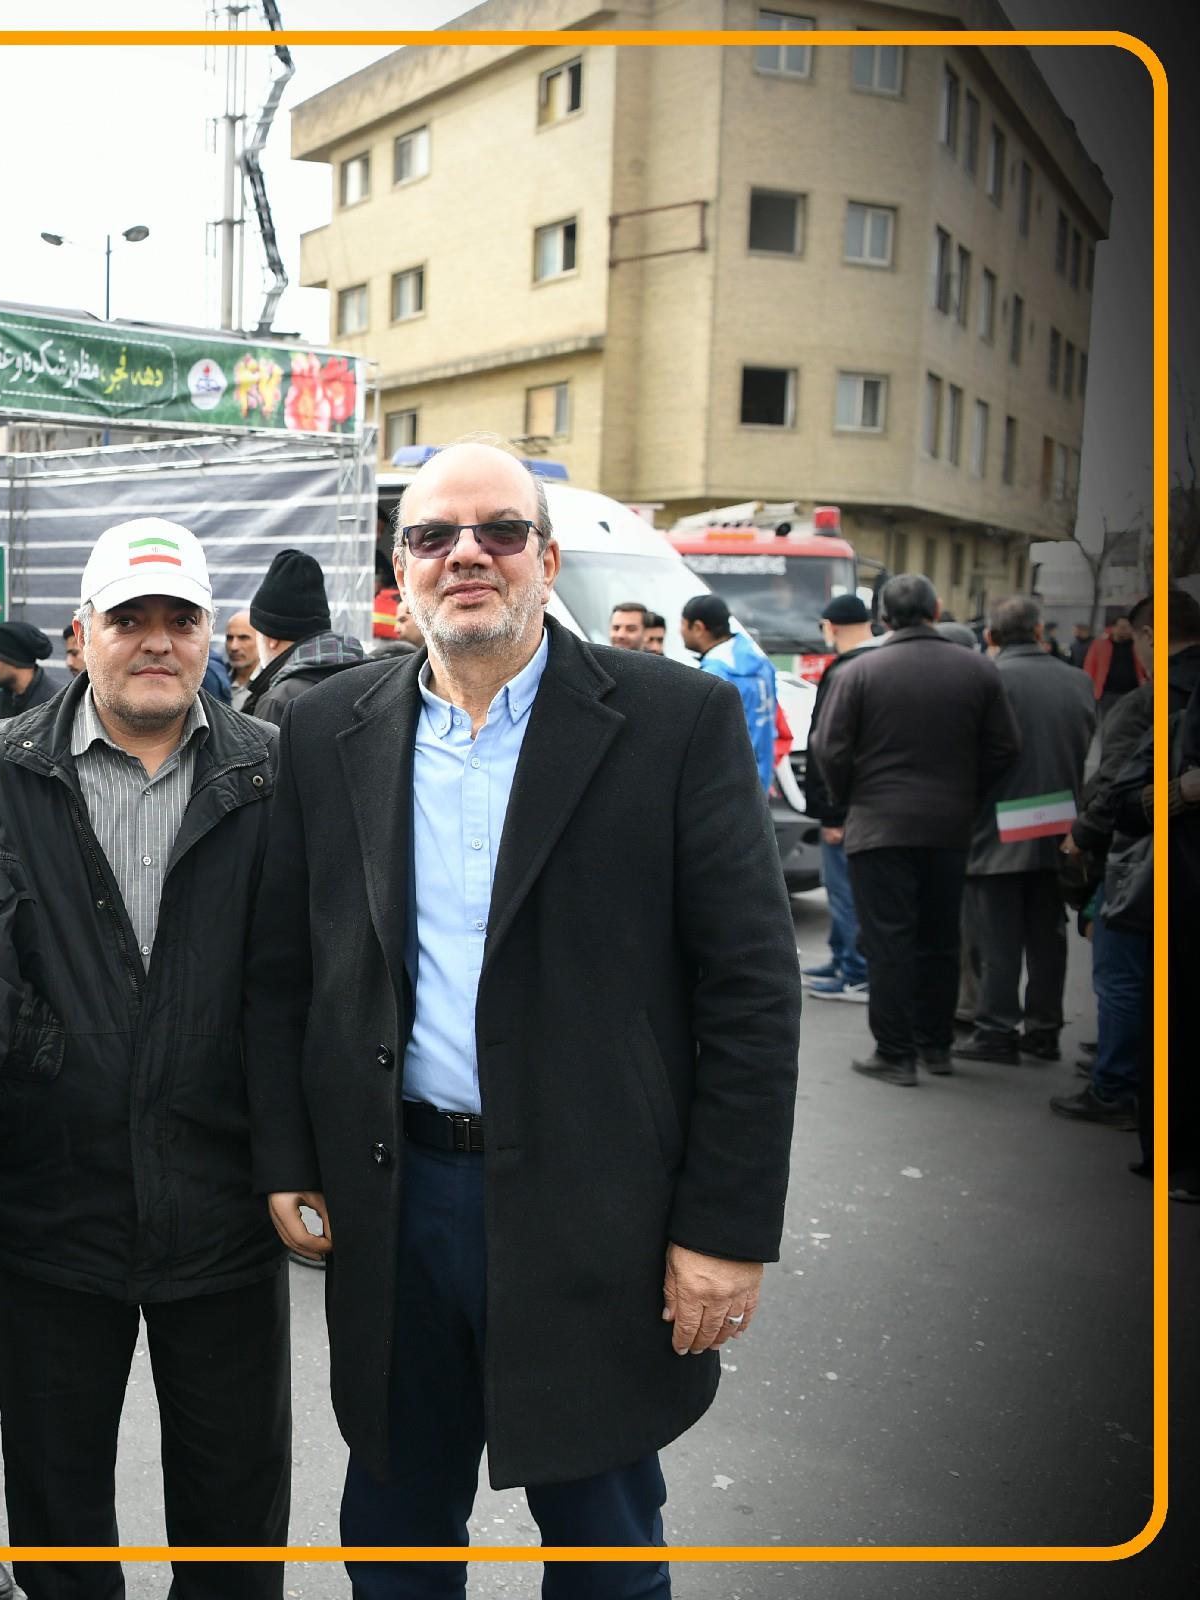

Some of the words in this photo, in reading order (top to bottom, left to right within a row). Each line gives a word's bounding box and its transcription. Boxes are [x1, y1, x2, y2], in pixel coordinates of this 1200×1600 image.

[9, 355, 22, 382] و
[25, 339, 68, 383] شکوه
[63, 347, 100, 389] مظهر
[130, 366, 164, 387] دهه
